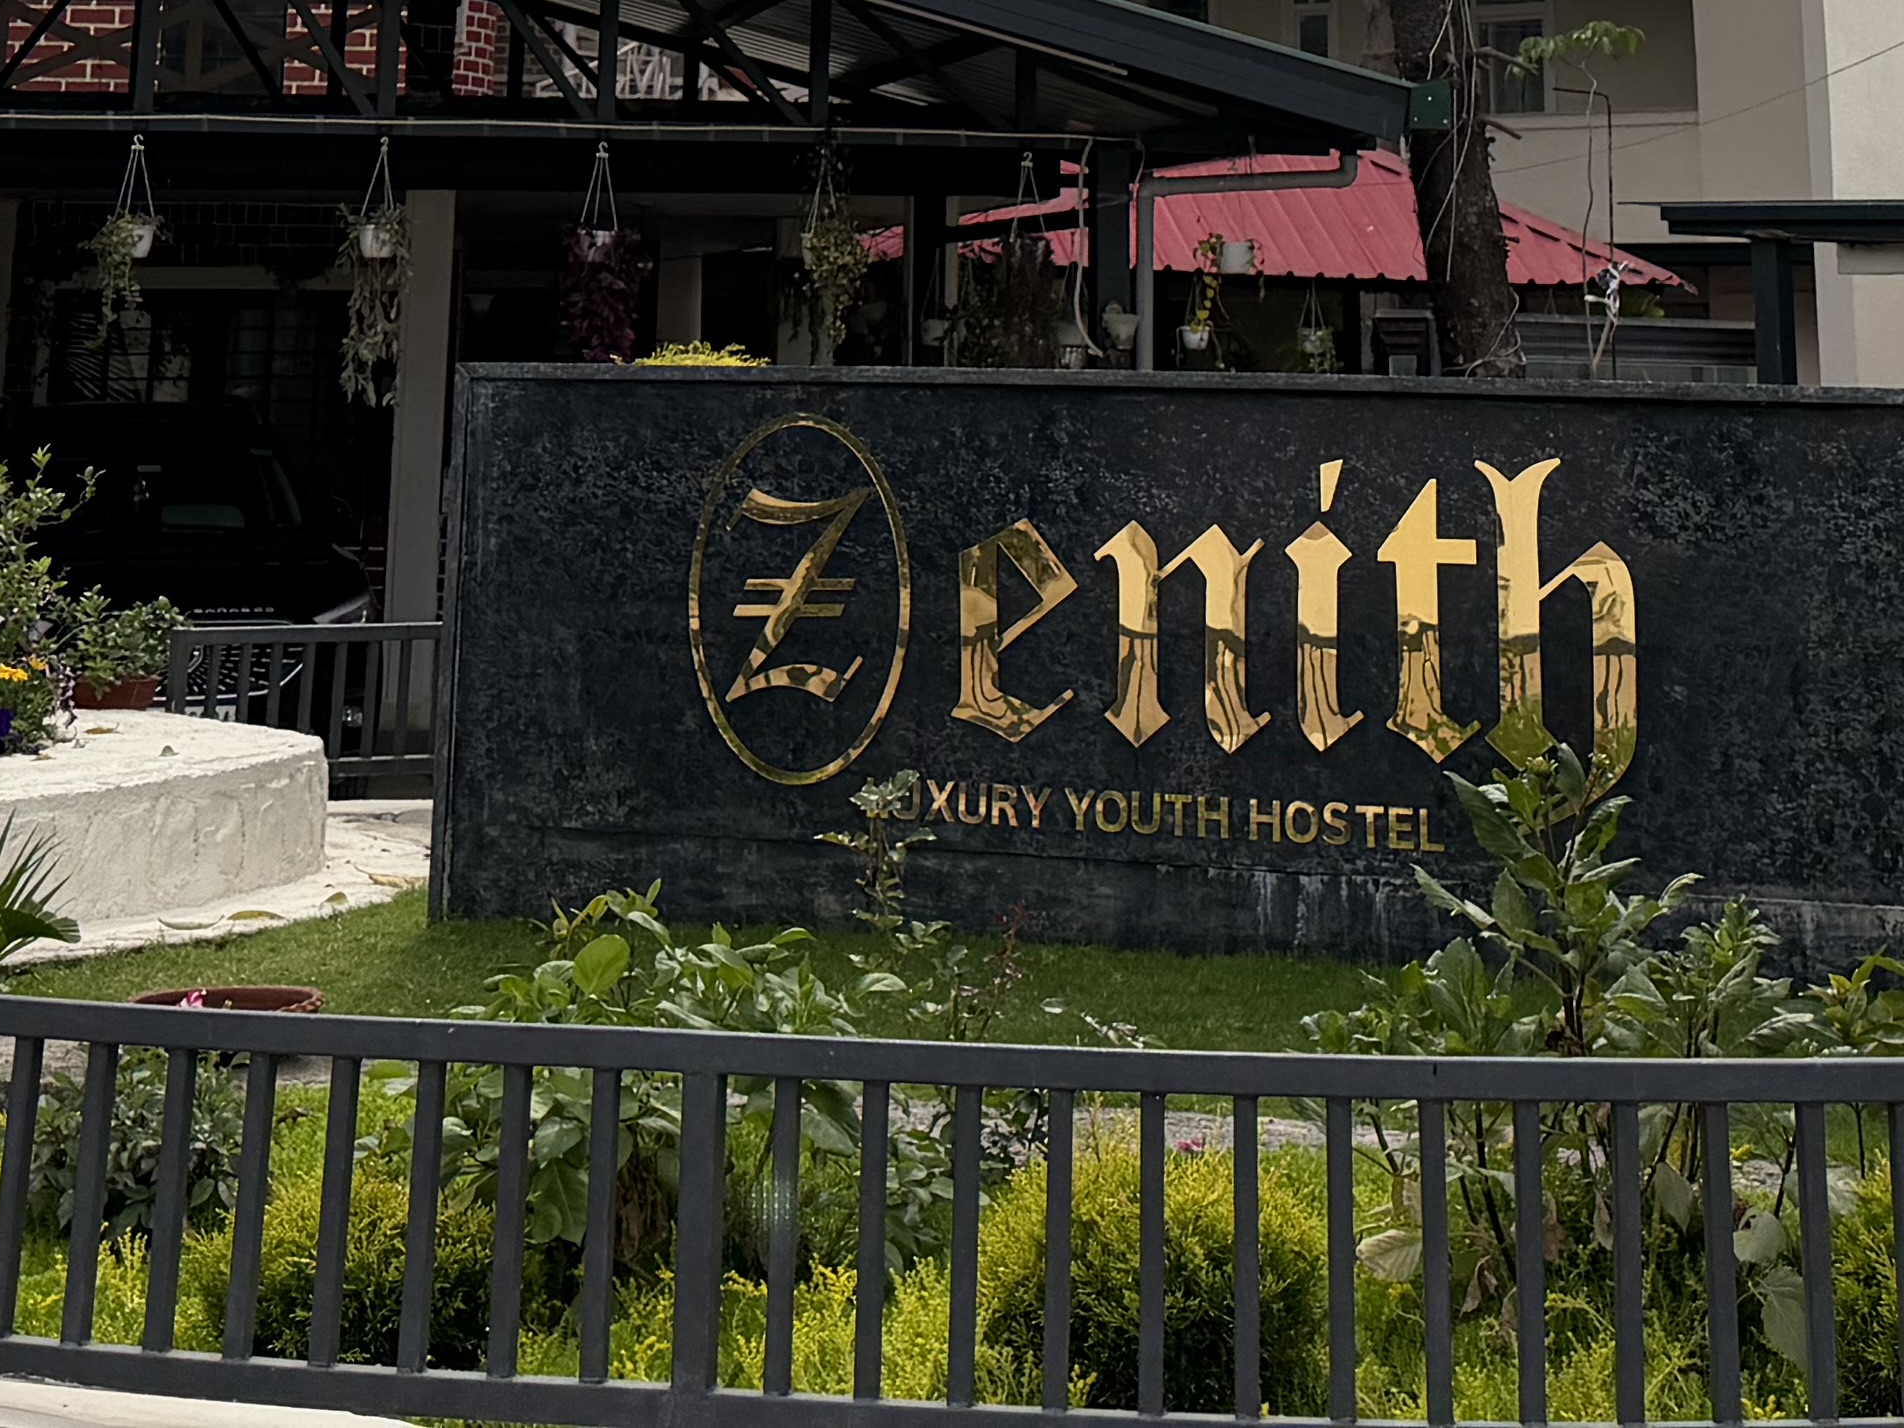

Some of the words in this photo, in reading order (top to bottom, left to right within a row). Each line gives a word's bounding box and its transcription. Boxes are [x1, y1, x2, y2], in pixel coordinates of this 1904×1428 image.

[865, 777, 1052, 829] UXURY
[1064, 787, 1231, 840] YOUTH
[1248, 798, 1446, 853] HOSTEL
